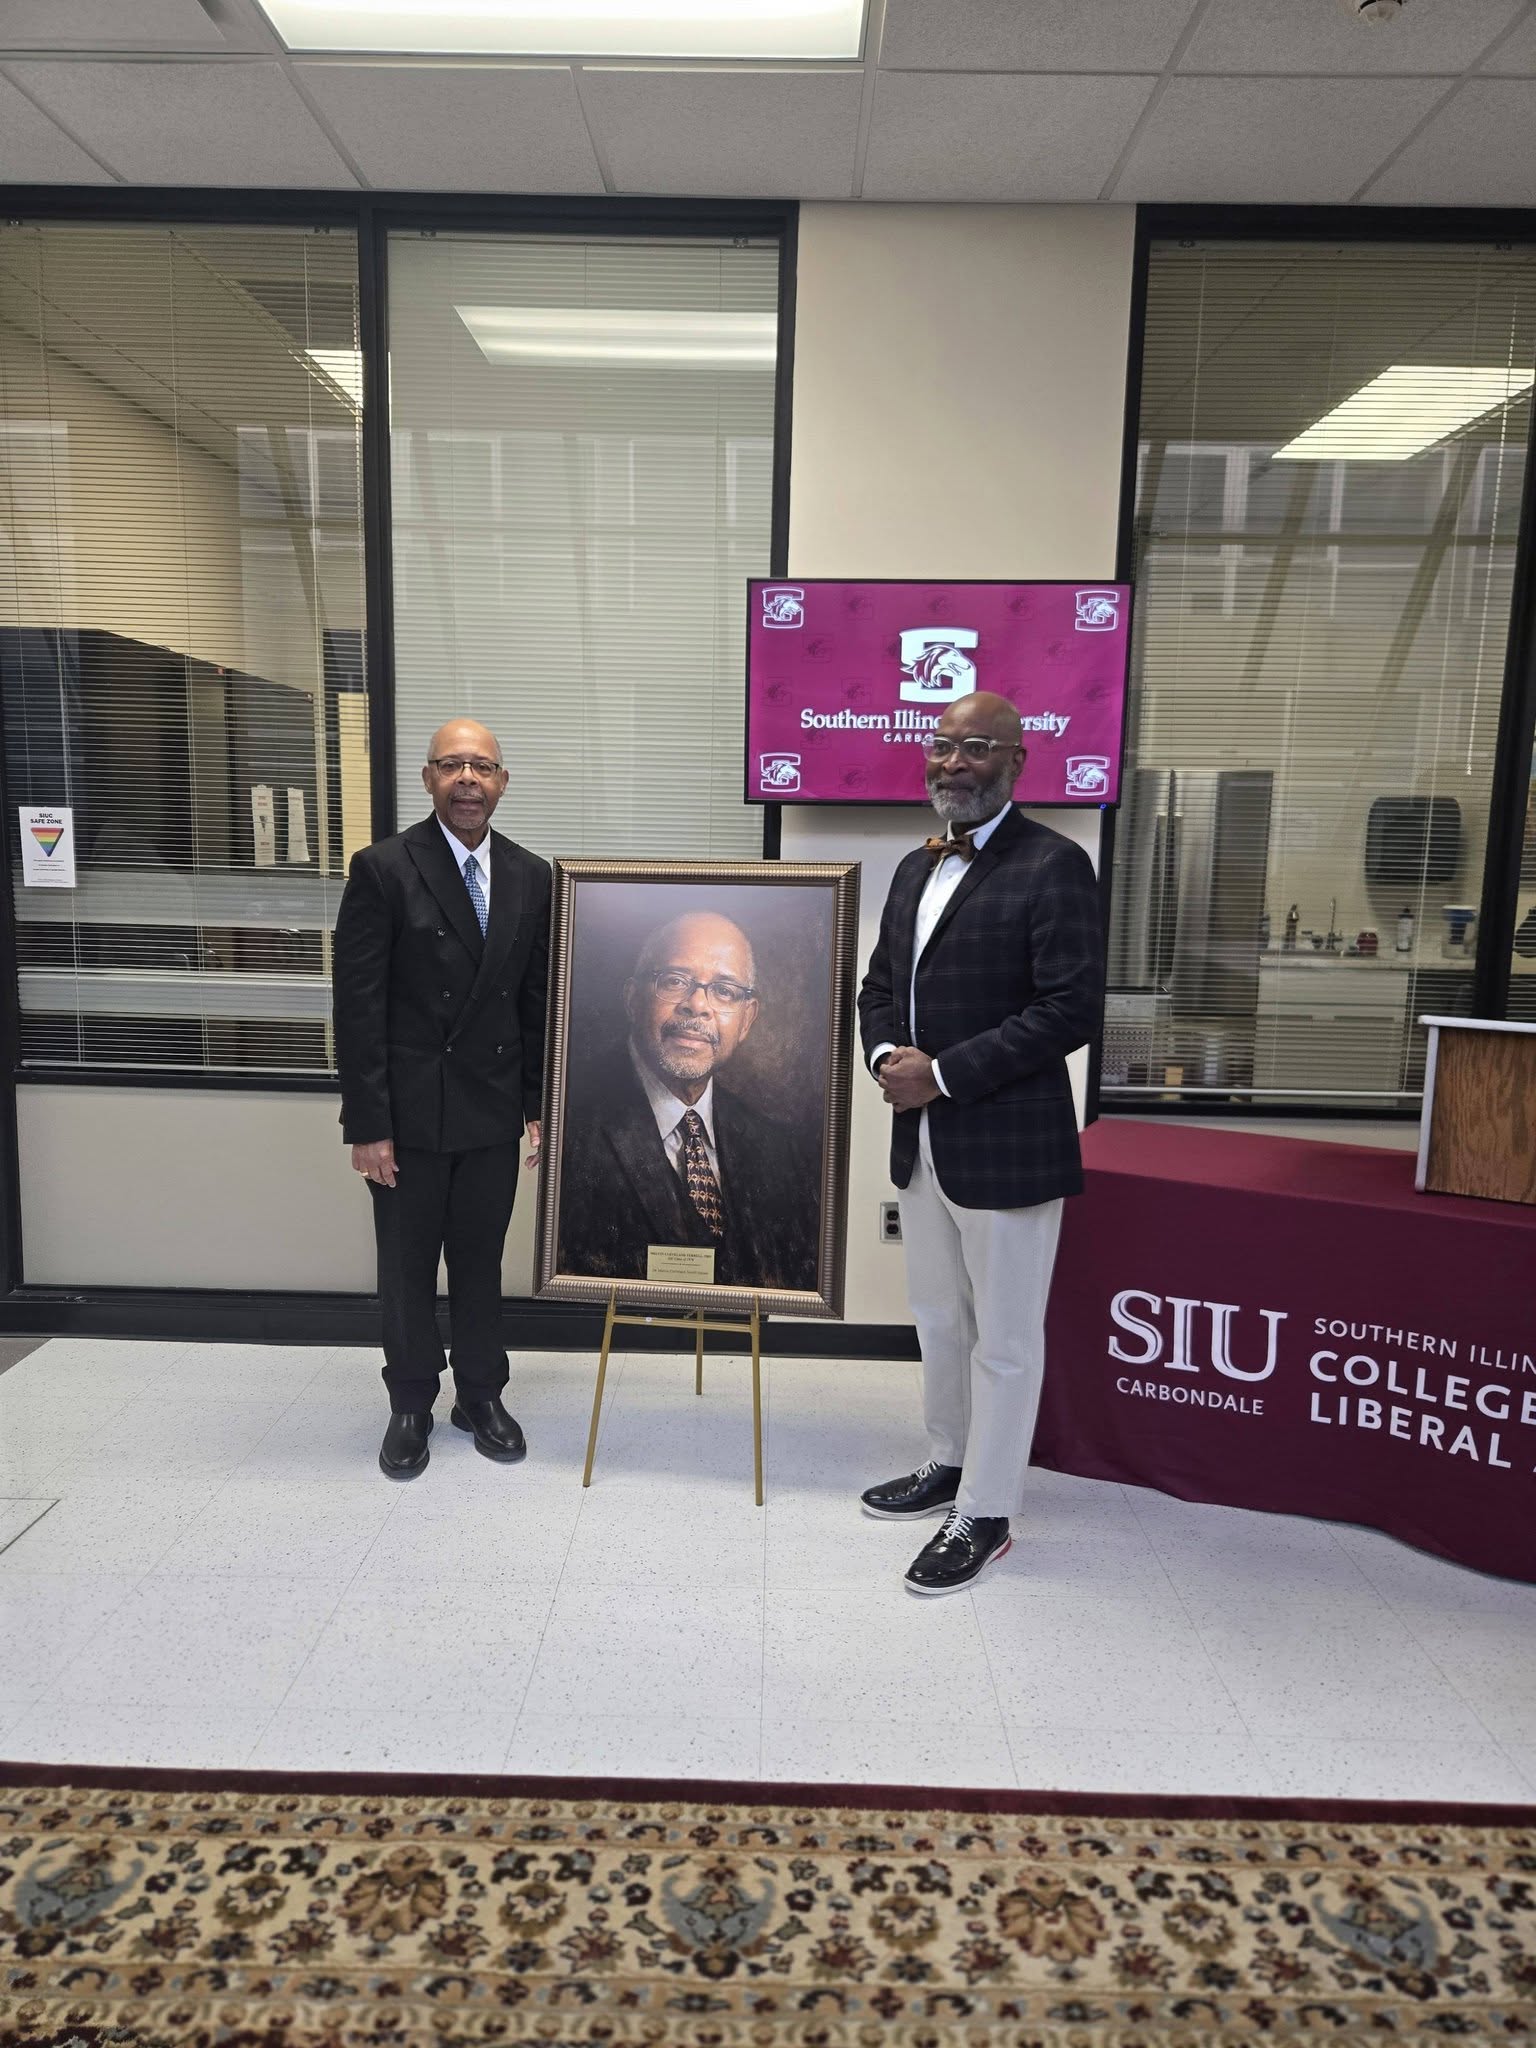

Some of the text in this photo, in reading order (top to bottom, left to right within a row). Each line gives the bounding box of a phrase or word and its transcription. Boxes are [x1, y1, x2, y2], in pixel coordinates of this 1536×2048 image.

[800, 708, 891, 729] Southern
[1020, 711, 1071, 737] rsity
[1108, 1289, 1288, 1382] SIU
[1314, 1317, 1457, 1358] SOUTHERN
[1116, 1377, 1264, 1415] CARBONDALE
[1309, 1350, 1536, 1426] COLLEGE
[1310, 1392, 1511, 1469] LIBERAL
